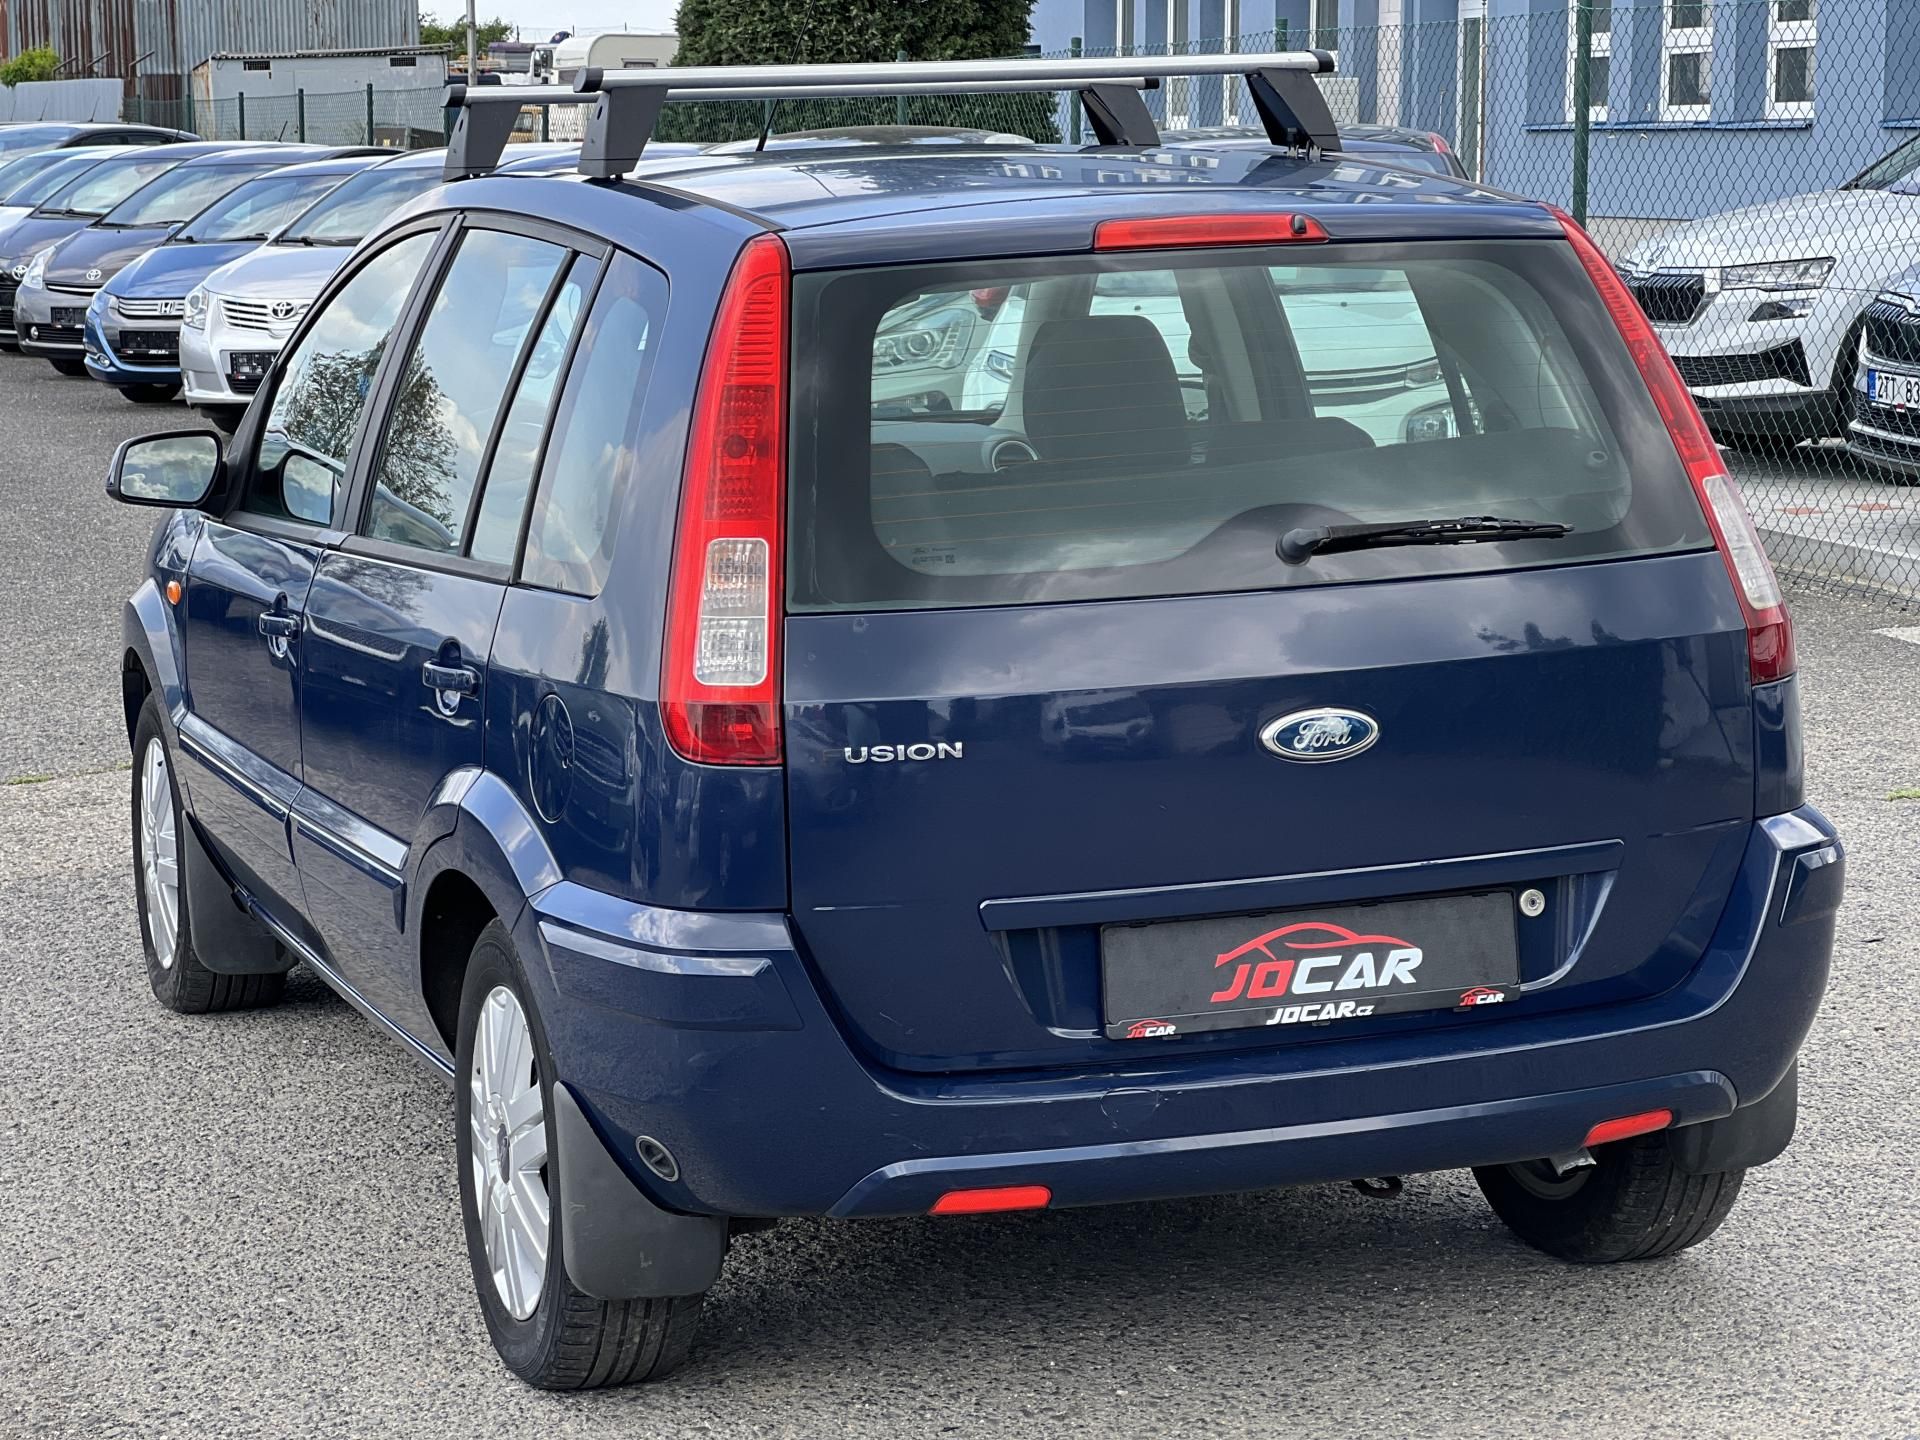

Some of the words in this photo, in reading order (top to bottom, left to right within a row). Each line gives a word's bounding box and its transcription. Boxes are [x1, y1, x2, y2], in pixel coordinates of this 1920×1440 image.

[1878, 374, 1897, 400] 2TT
[1905, 380, 1920, 404] 83
[1293, 720, 1352, 749] Ford
[844, 741, 963, 764] USION
[1210, 947, 1423, 1003] JOCAR
[1459, 993, 1505, 1006] JOCAR
[1266, 1000, 1376, 1026] JOCAR.cz
[1126, 1025, 1177, 1039] JOCAR
